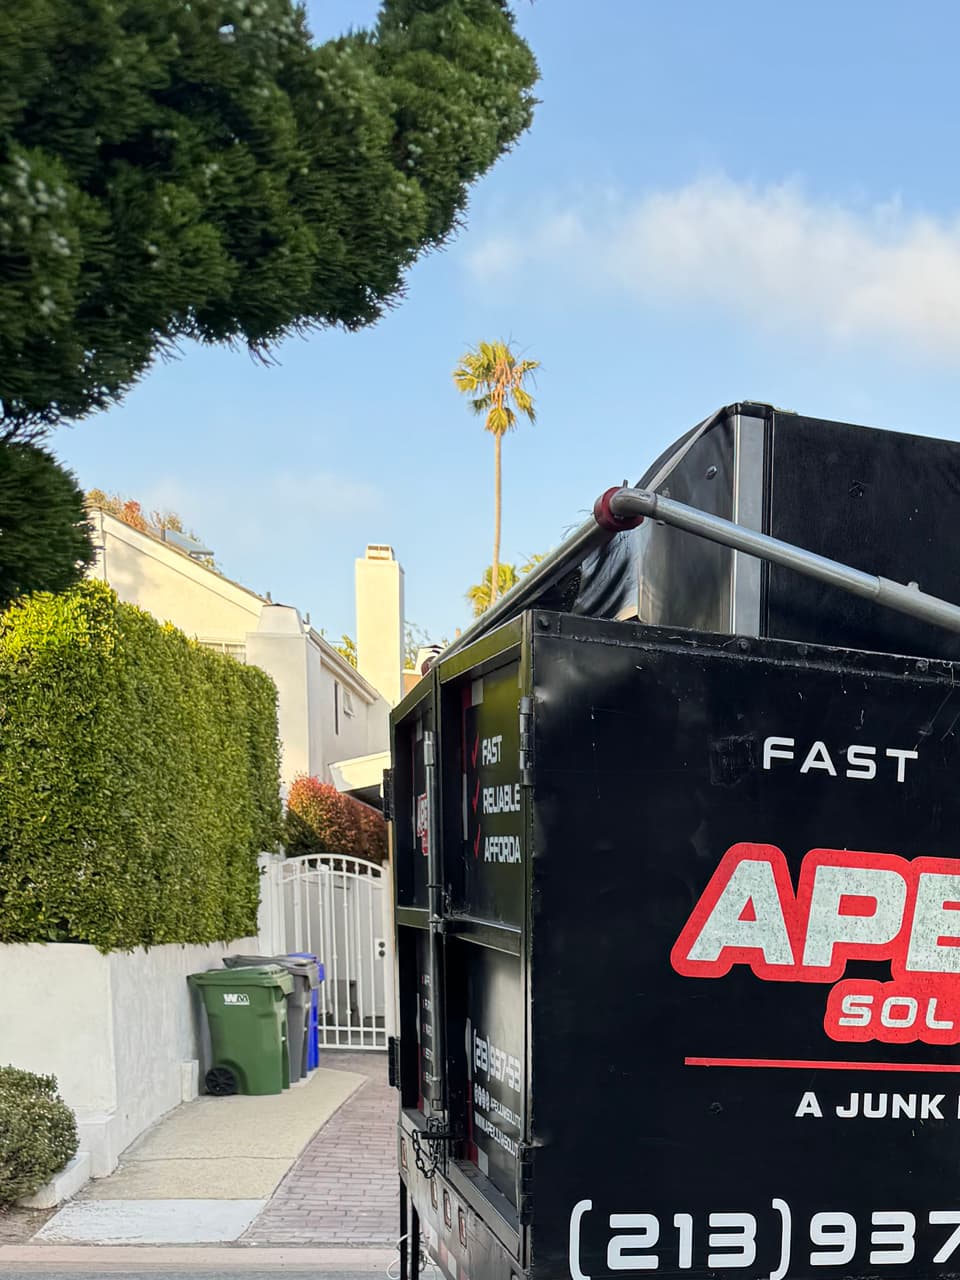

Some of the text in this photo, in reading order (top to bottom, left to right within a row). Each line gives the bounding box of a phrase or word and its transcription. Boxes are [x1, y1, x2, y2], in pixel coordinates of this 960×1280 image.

[482, 735, 503, 766] FAST
[763, 736, 919, 783] FAST
[482, 783, 521, 815] RELIABLE
[223, 993, 250, 1006] WM
[794, 1091, 823, 1119] A
[836, 1092, 946, 1120] JUNK
